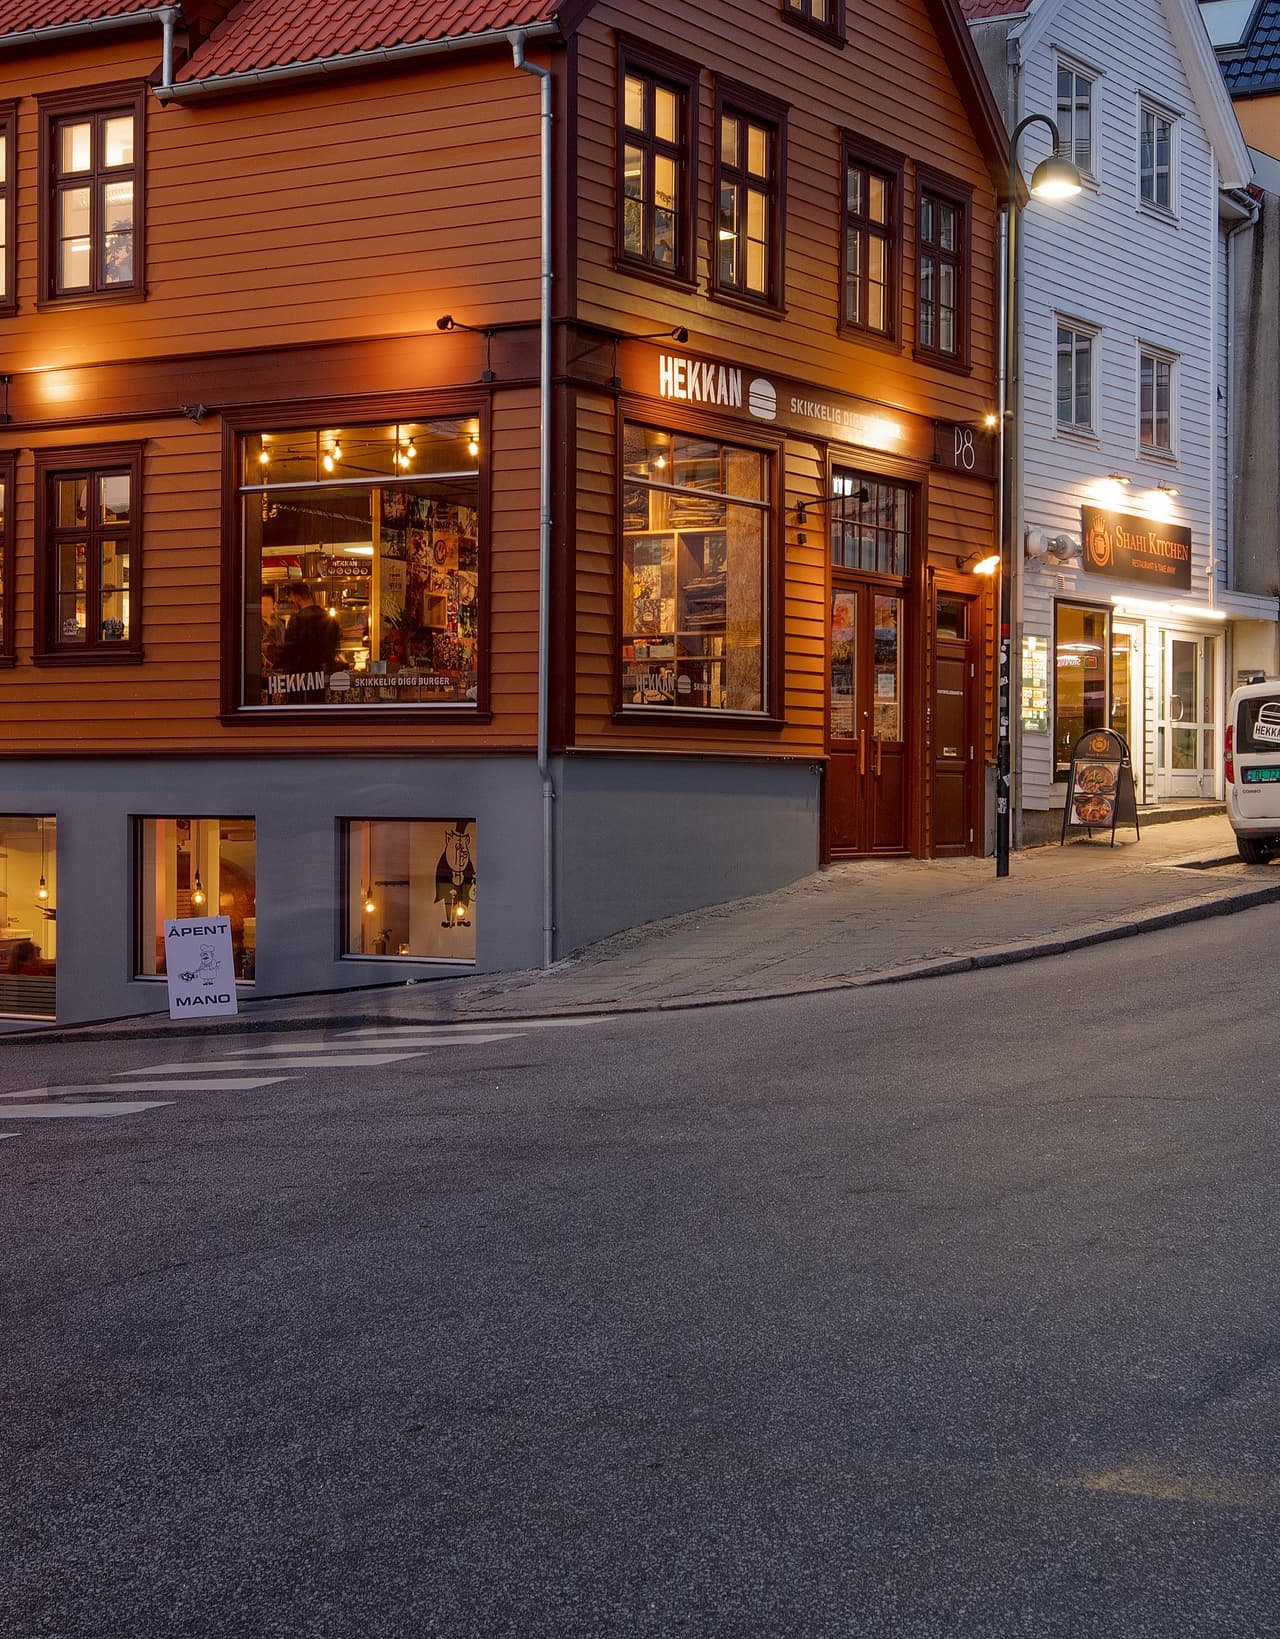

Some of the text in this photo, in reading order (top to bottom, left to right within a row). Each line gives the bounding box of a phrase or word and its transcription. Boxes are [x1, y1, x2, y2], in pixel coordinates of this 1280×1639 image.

[659, 354, 742, 408] HEKKAN
[790, 397, 841, 424] SKIKKELIG
[954, 426, 975, 470] P8
[1116, 525, 1189, 561] SHAHI KITCHEN
[268, 671, 450, 694] HEKKAN SKIKKELIG DIGG BURGER
[636, 673, 675, 692] HEKKAN
[168, 924, 228, 938] ÅPENT
[175, 993, 231, 1007] MANO
